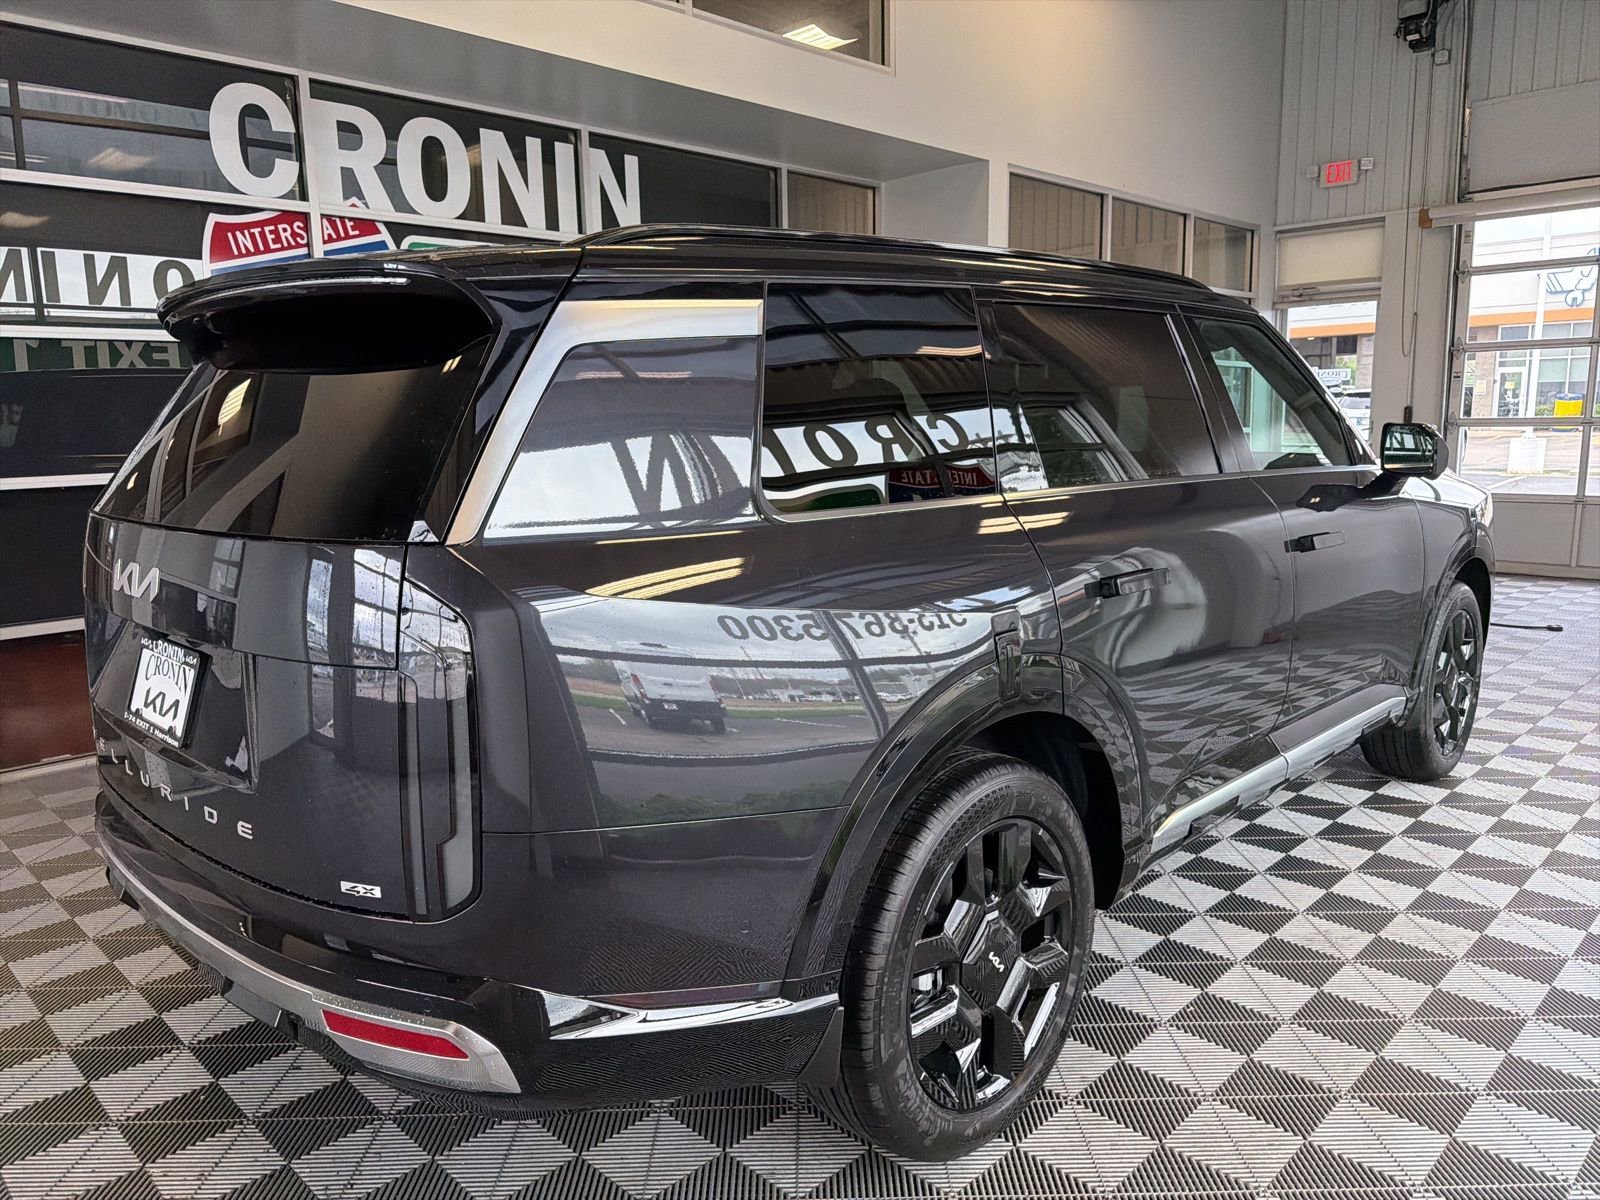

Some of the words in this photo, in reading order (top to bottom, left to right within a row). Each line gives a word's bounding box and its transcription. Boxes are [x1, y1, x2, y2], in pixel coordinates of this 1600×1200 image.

[209, 82, 642, 232] CRONIN
[1327, 160, 1353, 184] EXIT
[227, 216, 360, 256] INTERSATE
[113, 558, 159, 602] KIA
[145, 654, 191, 697] CRONIN
[143, 687, 180, 722] KIA
[92, 727, 254, 840] ELLURIDE
